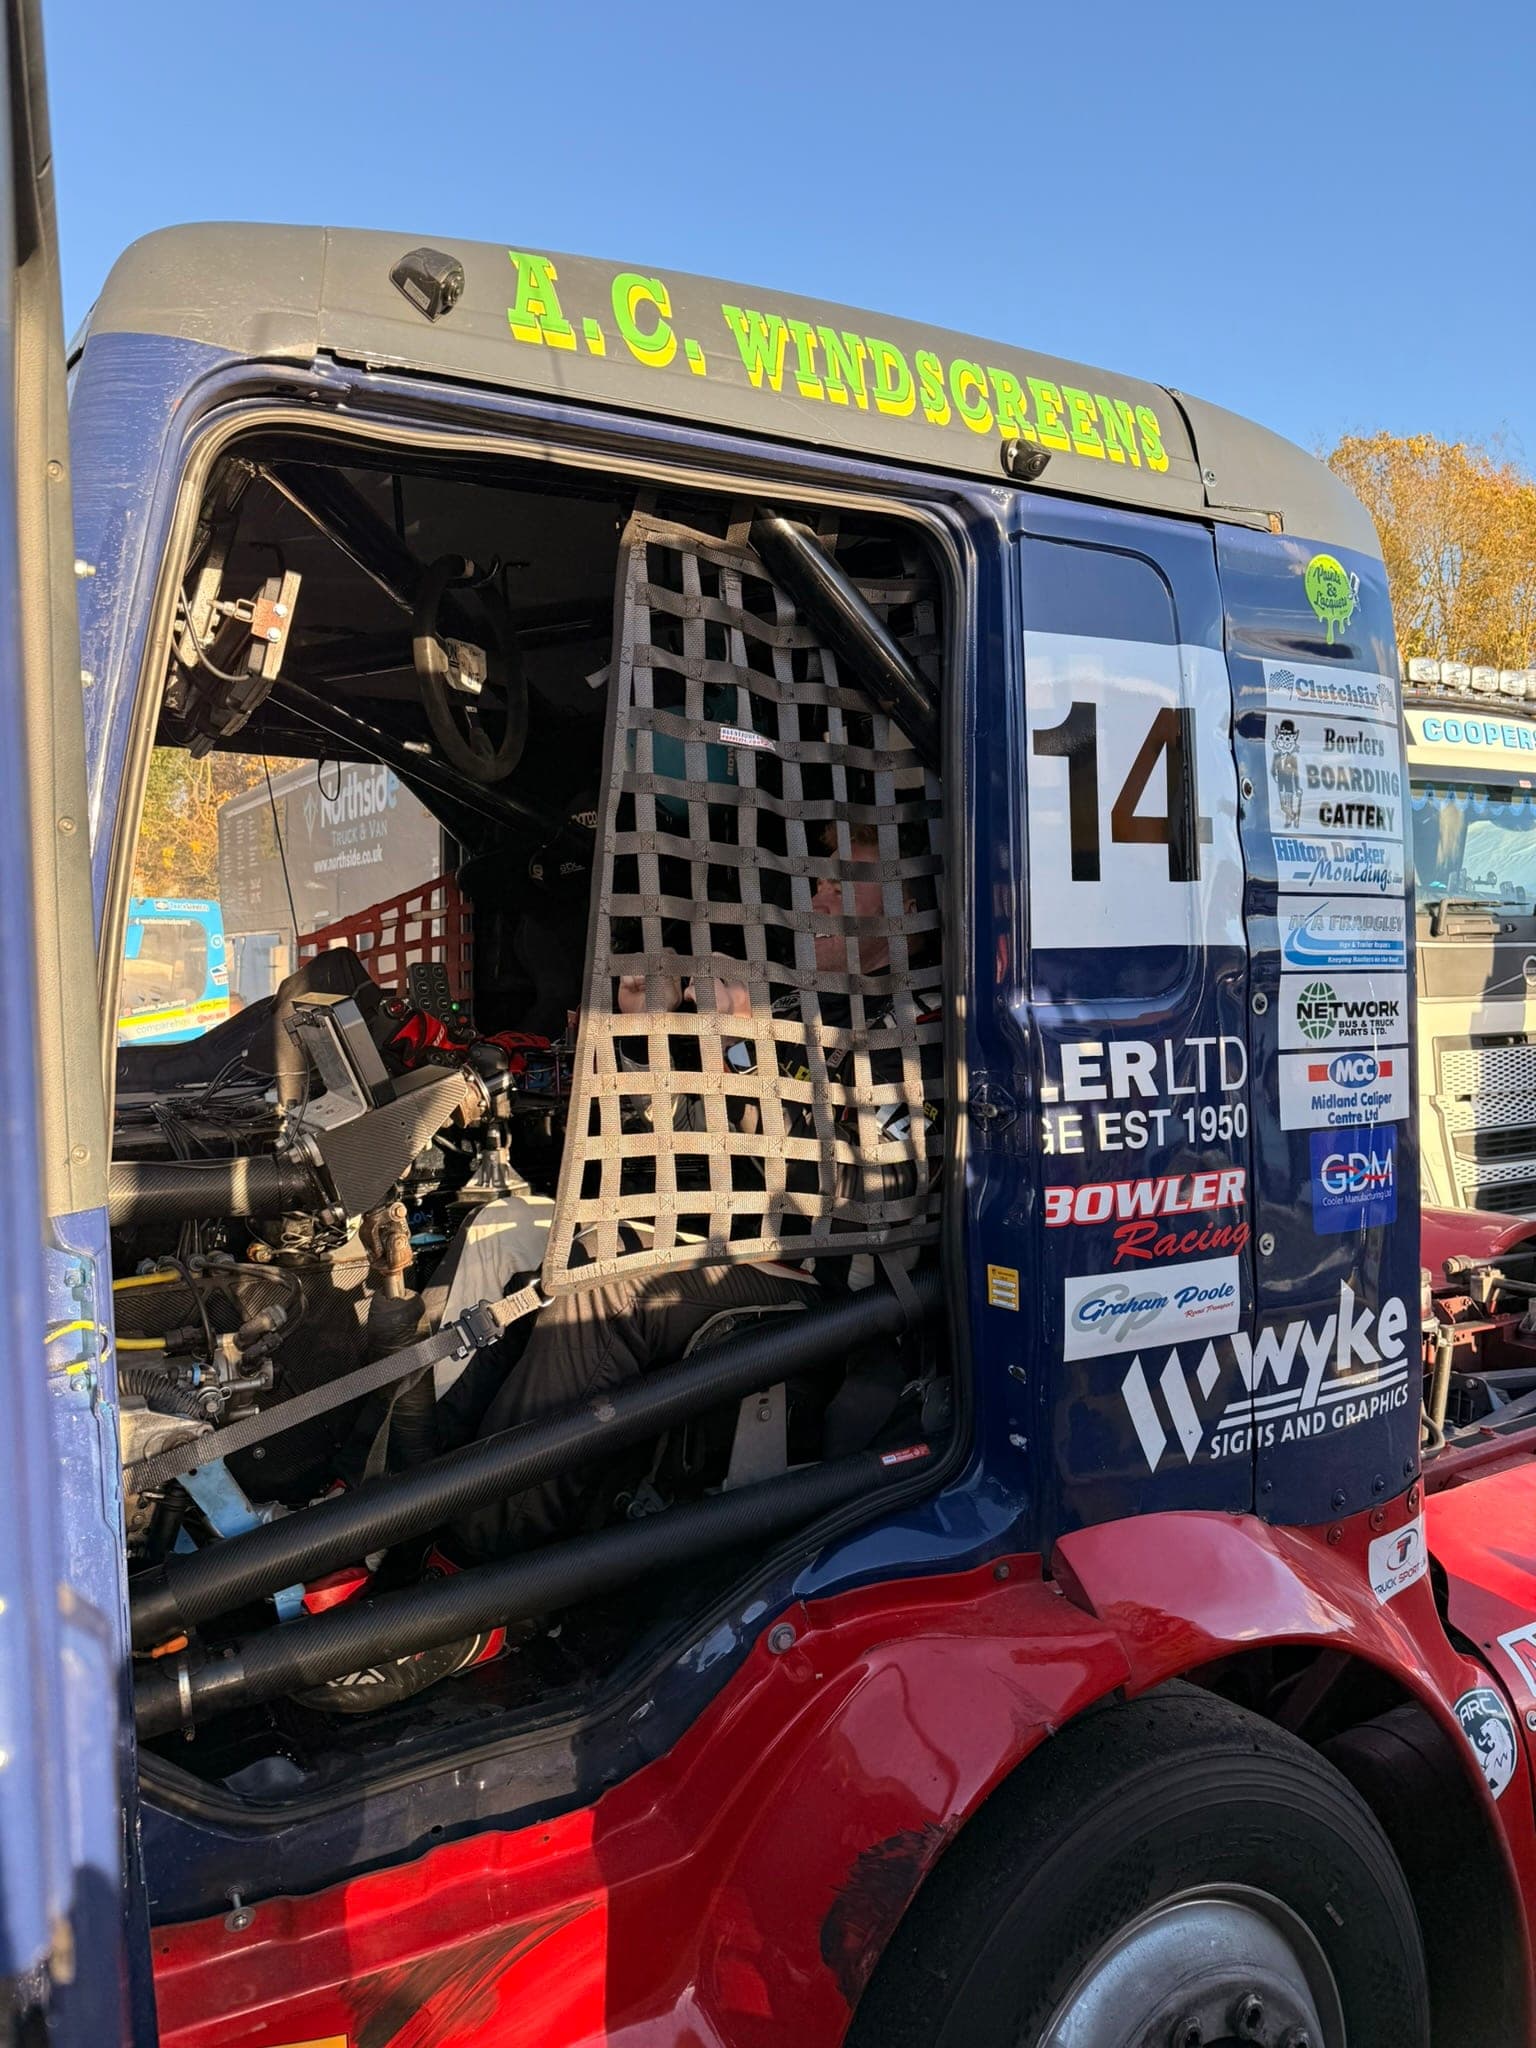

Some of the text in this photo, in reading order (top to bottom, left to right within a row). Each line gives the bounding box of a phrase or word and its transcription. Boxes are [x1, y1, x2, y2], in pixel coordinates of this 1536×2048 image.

[508, 251, 1169, 473] A.C. WINDSCREENS
[1327, 583, 1337, 598] &
[1296, 678, 1379, 706] Clutchfix
[1323, 728, 1384, 757] Bowlers
[1423, 717, 1536, 750] COOPER
[320, 764, 400, 829] Northside
[1033, 702, 1213, 882] 14
[1306, 764, 1400, 797] BOARDING
[1320, 802, 1394, 832] CATTERY
[1275, 839, 1385, 864] Hilton Docker
[1309, 858, 1392, 891] Mouldings
[1297, 1000, 1399, 1019] NETWORK
[1339, 1019, 1394, 1028] BUS & TRUCK
[1339, 1027, 1387, 1036] PARTS LTD.
[1164, 1036, 1248, 1095] LTD
[1336, 1059, 1375, 1083] MCC
[1312, 1092, 1392, 1110] Midland Caliper
[1328, 1107, 1379, 1124] Centre Ltd
[1098, 1110, 1171, 1151] EST
[1183, 1102, 1247, 1144] 1950
[1320, 1149, 1393, 1194] GDM
[1044, 1168, 1247, 1227] BOWLER
[1322, 1195, 1344, 1206] Cooler
[1345, 1190, 1383, 1203] Manufacturing
[1112, 1221, 1250, 1265] Racing
[1079, 1282, 1235, 1321] Graham Poole
[1230, 1279, 1408, 1411] wyke
[1210, 1383, 1408, 1460] SIGNS AND GRAPHICS
[1375, 1577, 1397, 1594] TRUCK
[1398, 1562, 1420, 1583] SPORT
